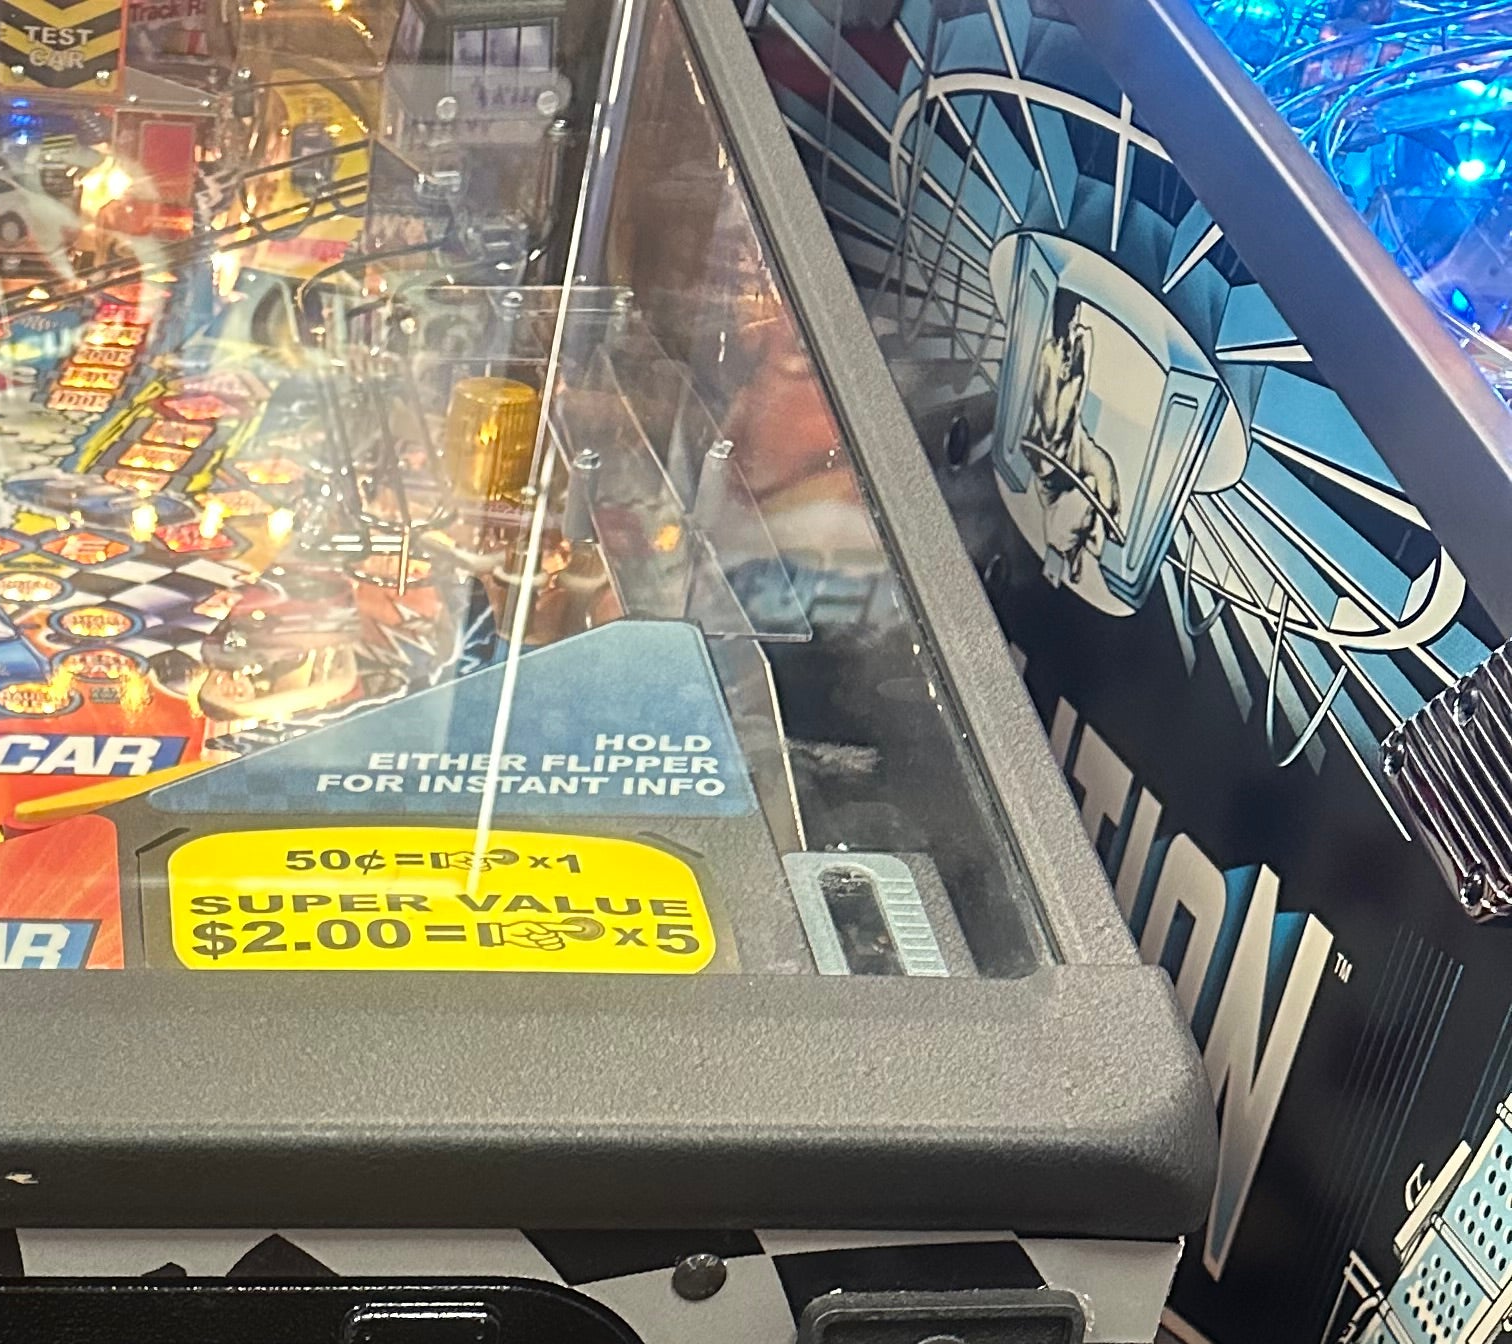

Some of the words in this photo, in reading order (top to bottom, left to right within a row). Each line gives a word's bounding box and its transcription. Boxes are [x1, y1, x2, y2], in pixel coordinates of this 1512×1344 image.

[24, 25, 94, 45] TEST
[28, 47, 84, 71] CAR
[595, 734, 712, 753] HOLD
[368, 752, 527, 771] EITHER
[542, 755, 718, 774] FLIPPER
[316, 774, 403, 792] FOR
[418, 775, 609, 794] INSTANT
[622, 777, 725, 796] INFO
[190, 893, 433, 915] SUPER
[456, 893, 692, 918] VALUE
[615, 924, 701, 954] x5
